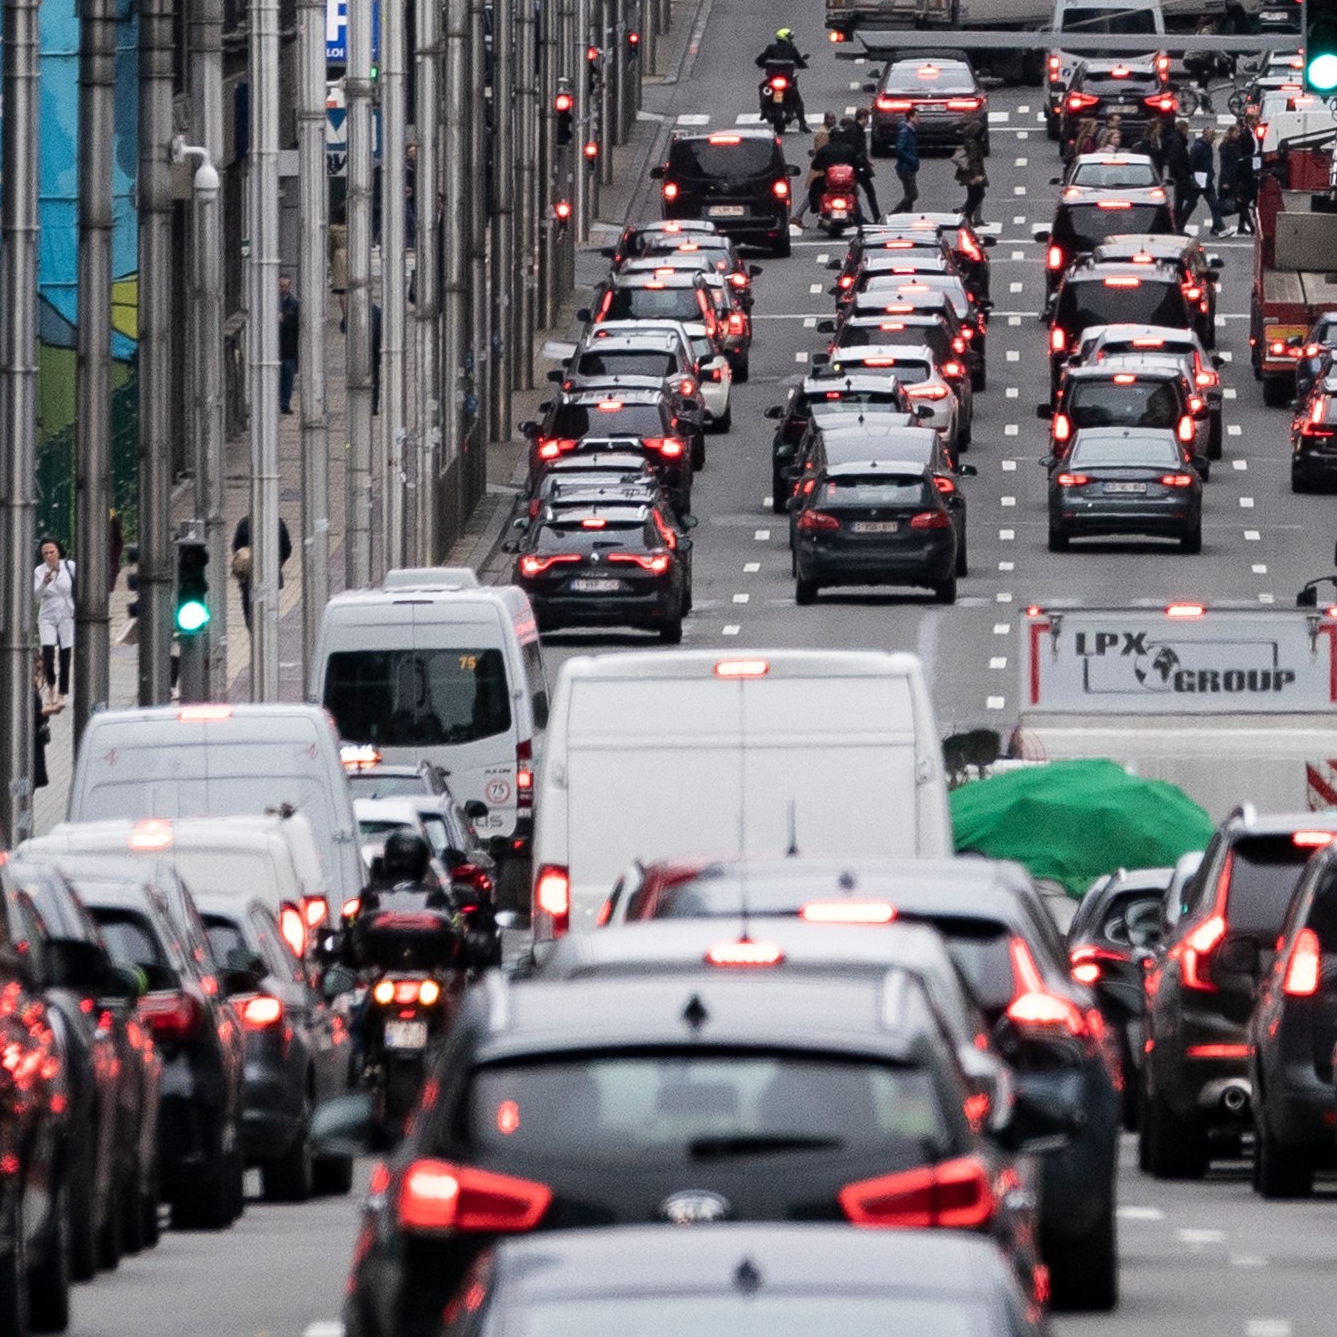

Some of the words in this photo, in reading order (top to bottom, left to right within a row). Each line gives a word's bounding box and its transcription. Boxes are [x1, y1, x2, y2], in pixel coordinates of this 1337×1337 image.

[1075, 632, 1148, 656] LPX
[459, 657, 476, 669] 75
[1174, 670, 1296, 693] GROUP
